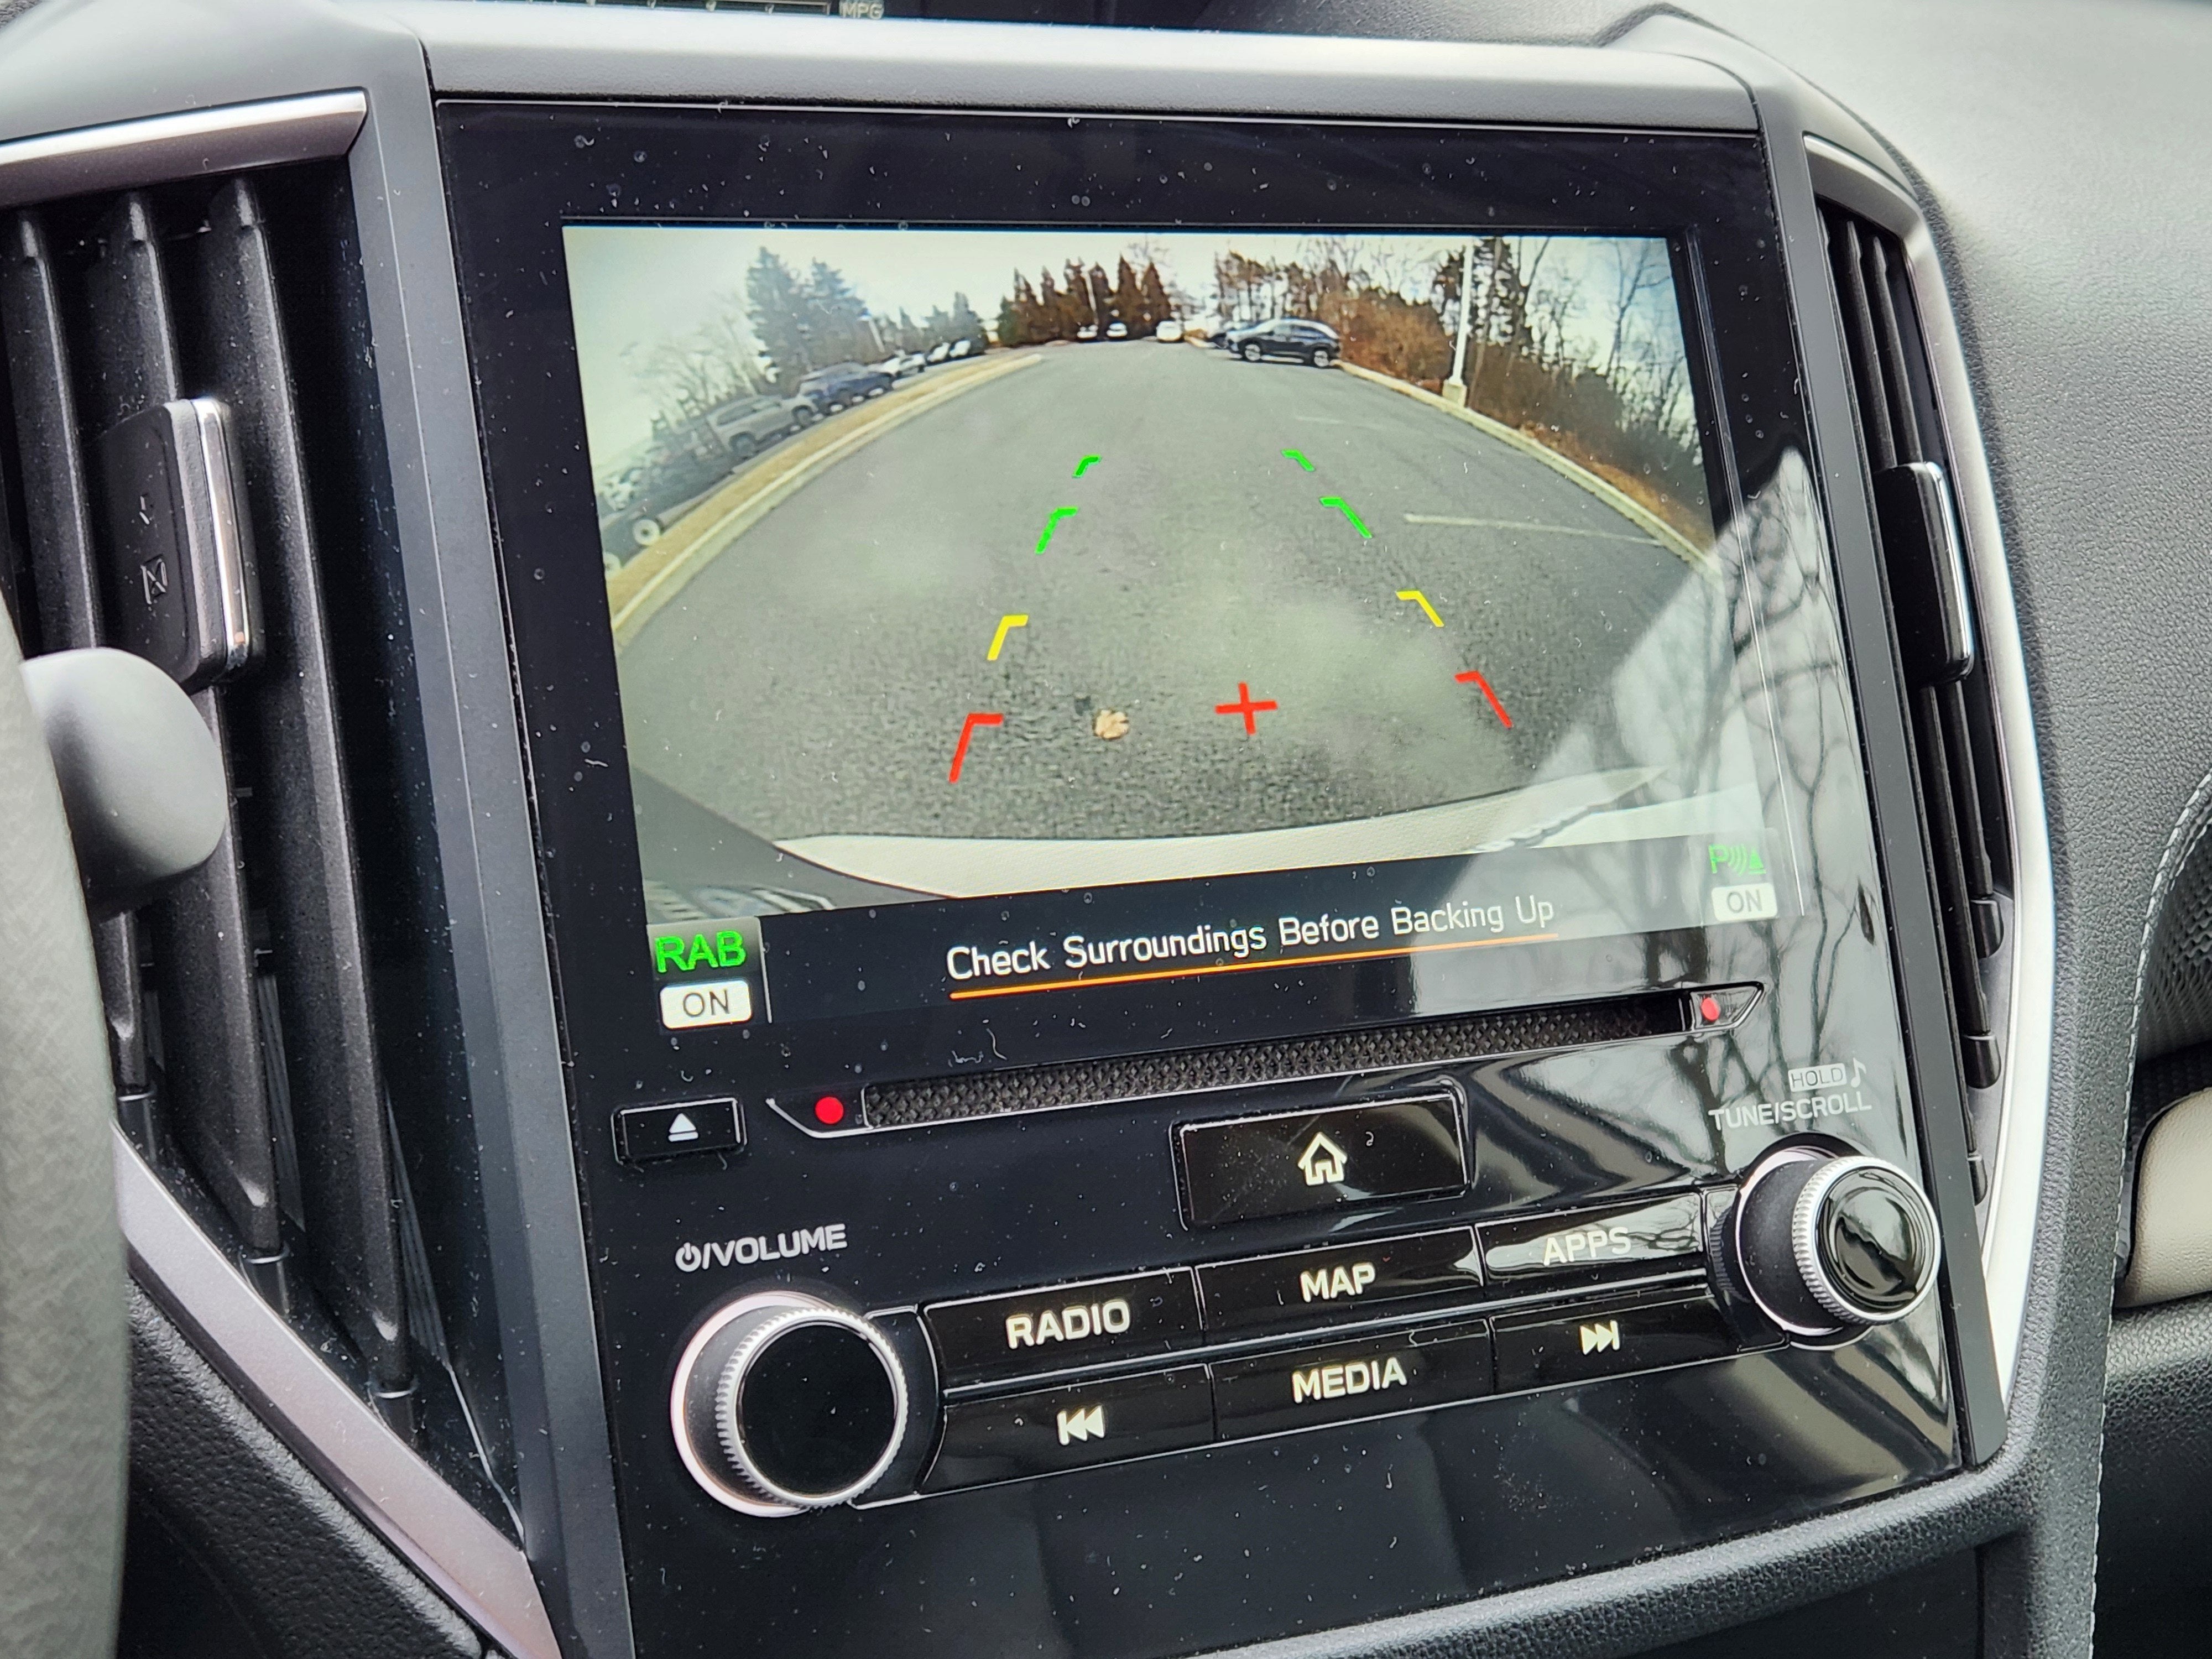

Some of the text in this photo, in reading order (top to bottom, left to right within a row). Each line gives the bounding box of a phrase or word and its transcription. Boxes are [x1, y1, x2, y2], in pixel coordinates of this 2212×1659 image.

[841, 2, 884, 20] MPG
[1726, 889, 1764, 914] ON
[655, 931, 747, 973] RAB
[946, 894, 1555, 980] Check Surroundings Before Backing Up
[682, 989, 730, 1018] ON
[1791, 1067, 1844, 1088] HOLD
[1708, 1091, 1872, 1131] TUNE/SCROLL
[1543, 1227, 1631, 1266] APPS
[1300, 1261, 1376, 1303] MAP
[1005, 1298, 1130, 1349] RADIO
[1292, 1357, 1408, 1404] MEDIA
